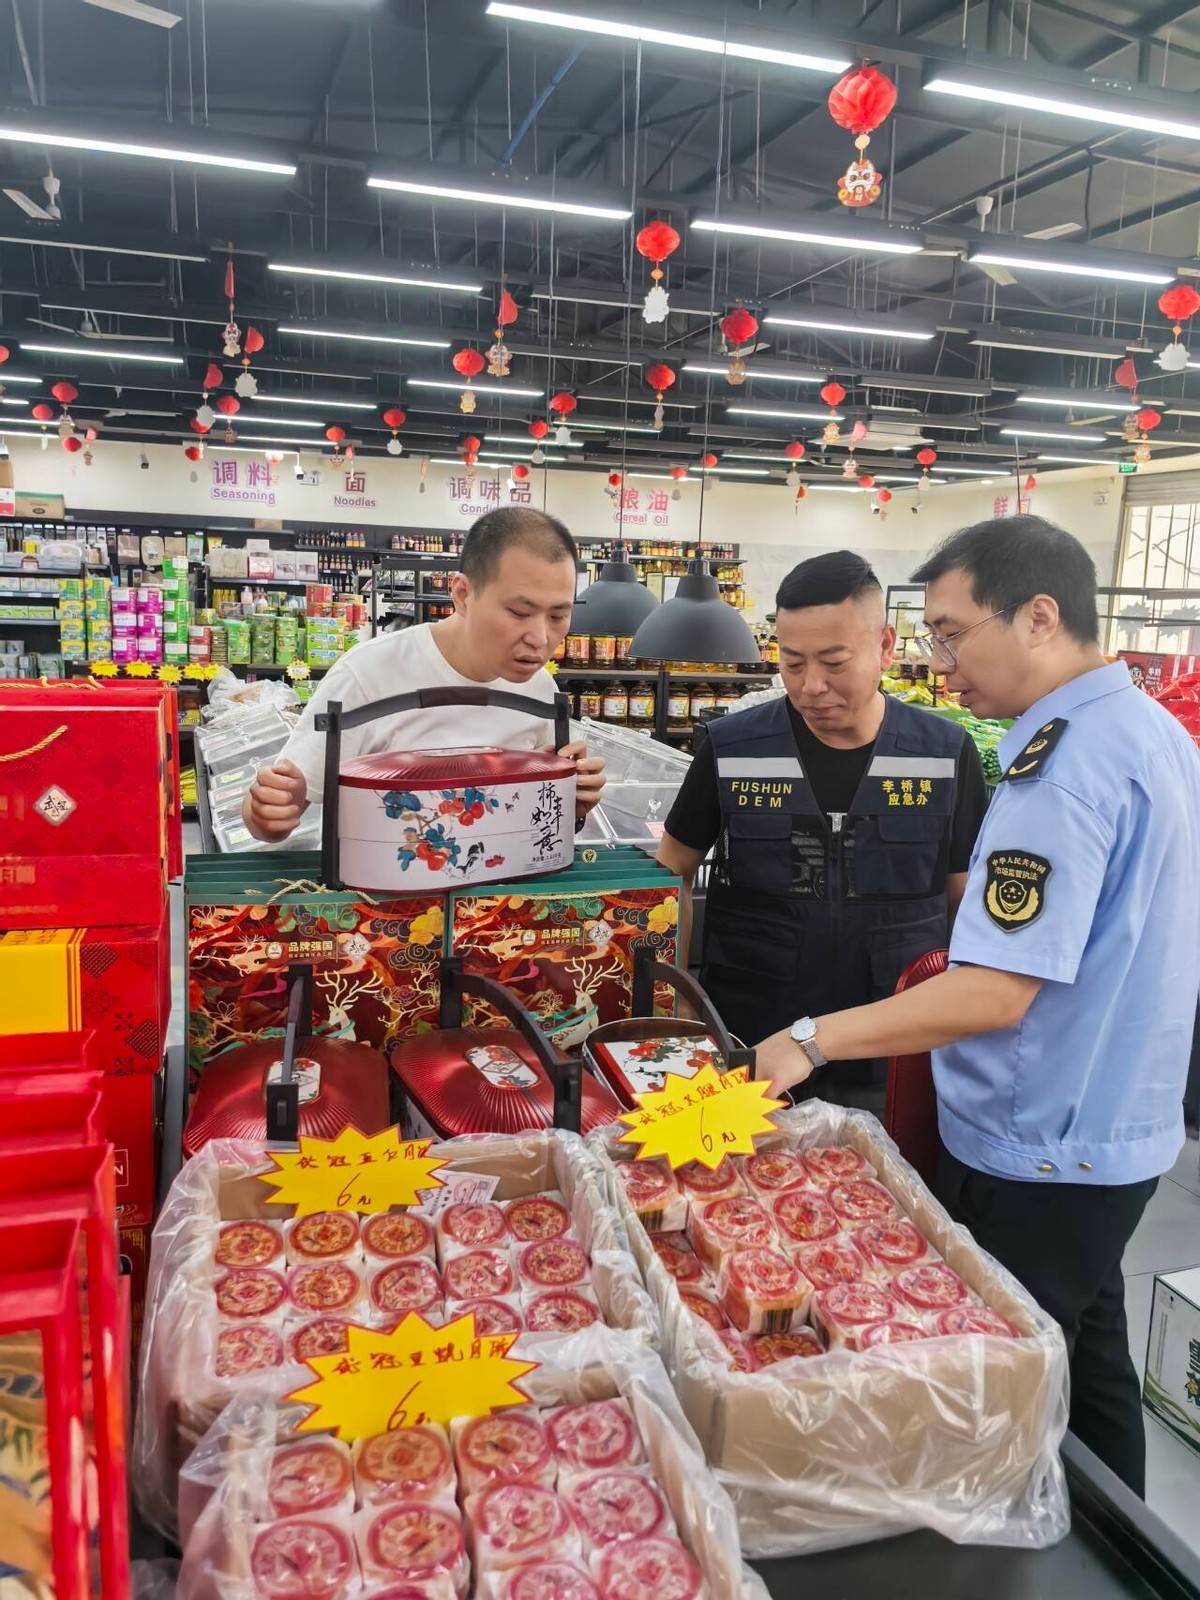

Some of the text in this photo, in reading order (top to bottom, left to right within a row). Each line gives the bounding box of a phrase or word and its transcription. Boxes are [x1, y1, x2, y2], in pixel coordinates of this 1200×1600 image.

[213, 460, 273, 487] 调料
[345, 472, 366, 493] 面
[213, 488, 276, 505] Seasoning
[449, 477, 532, 504] 调味品
[334, 496, 377, 508] Noodles
[654, 512, 669, 525] Oil
[731, 780, 793, 795] FUSHUN
[881, 778, 933, 793] 李桥镇
[738, 794, 783, 809] DEM
[888, 792, 929, 806] 应急办
[991, 856, 1047, 875] 中华人民共和国
[541, 927, 581, 939] 品牌强国
[288, 940, 333, 953] 品牌强国
